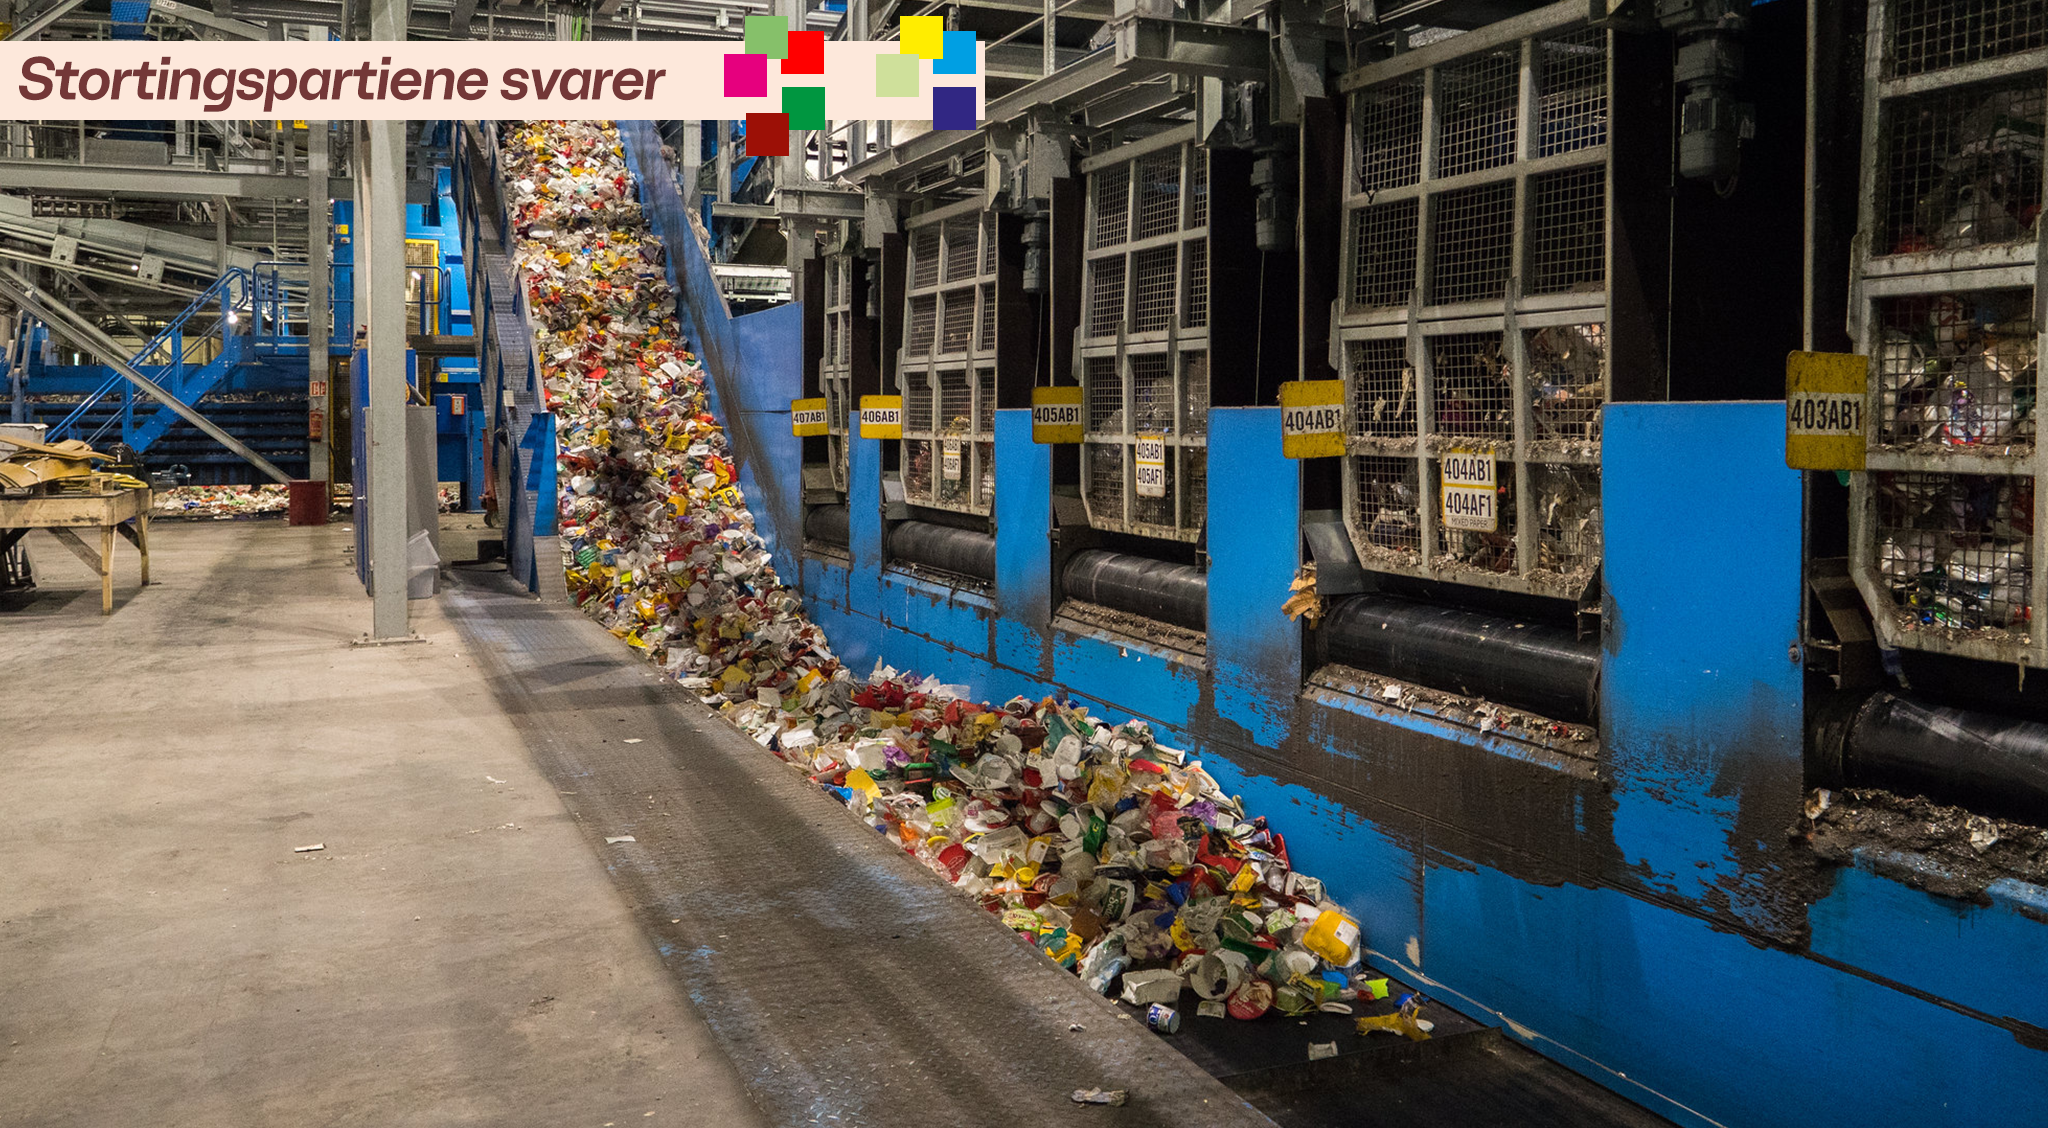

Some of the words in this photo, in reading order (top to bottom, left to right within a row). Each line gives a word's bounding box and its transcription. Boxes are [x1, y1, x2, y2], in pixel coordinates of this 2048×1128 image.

[793, 411, 826, 424] 407AB1
[861, 410, 899, 423] 406AB1
[1034, 407, 1079, 423] 405AB1
[1285, 408, 1341, 431] 404AB1
[1790, 398, 1860, 430] 403AB1
[1136, 442, 1163, 460] 405AB1
[1137, 468, 1163, 486] 405AF1
[1444, 458, 1491, 481] 404AB1
[1445, 492, 1491, 517] 404AF1
[1451, 518, 1469, 527] MIXED
[1469, 519, 1488, 528] PAPER
